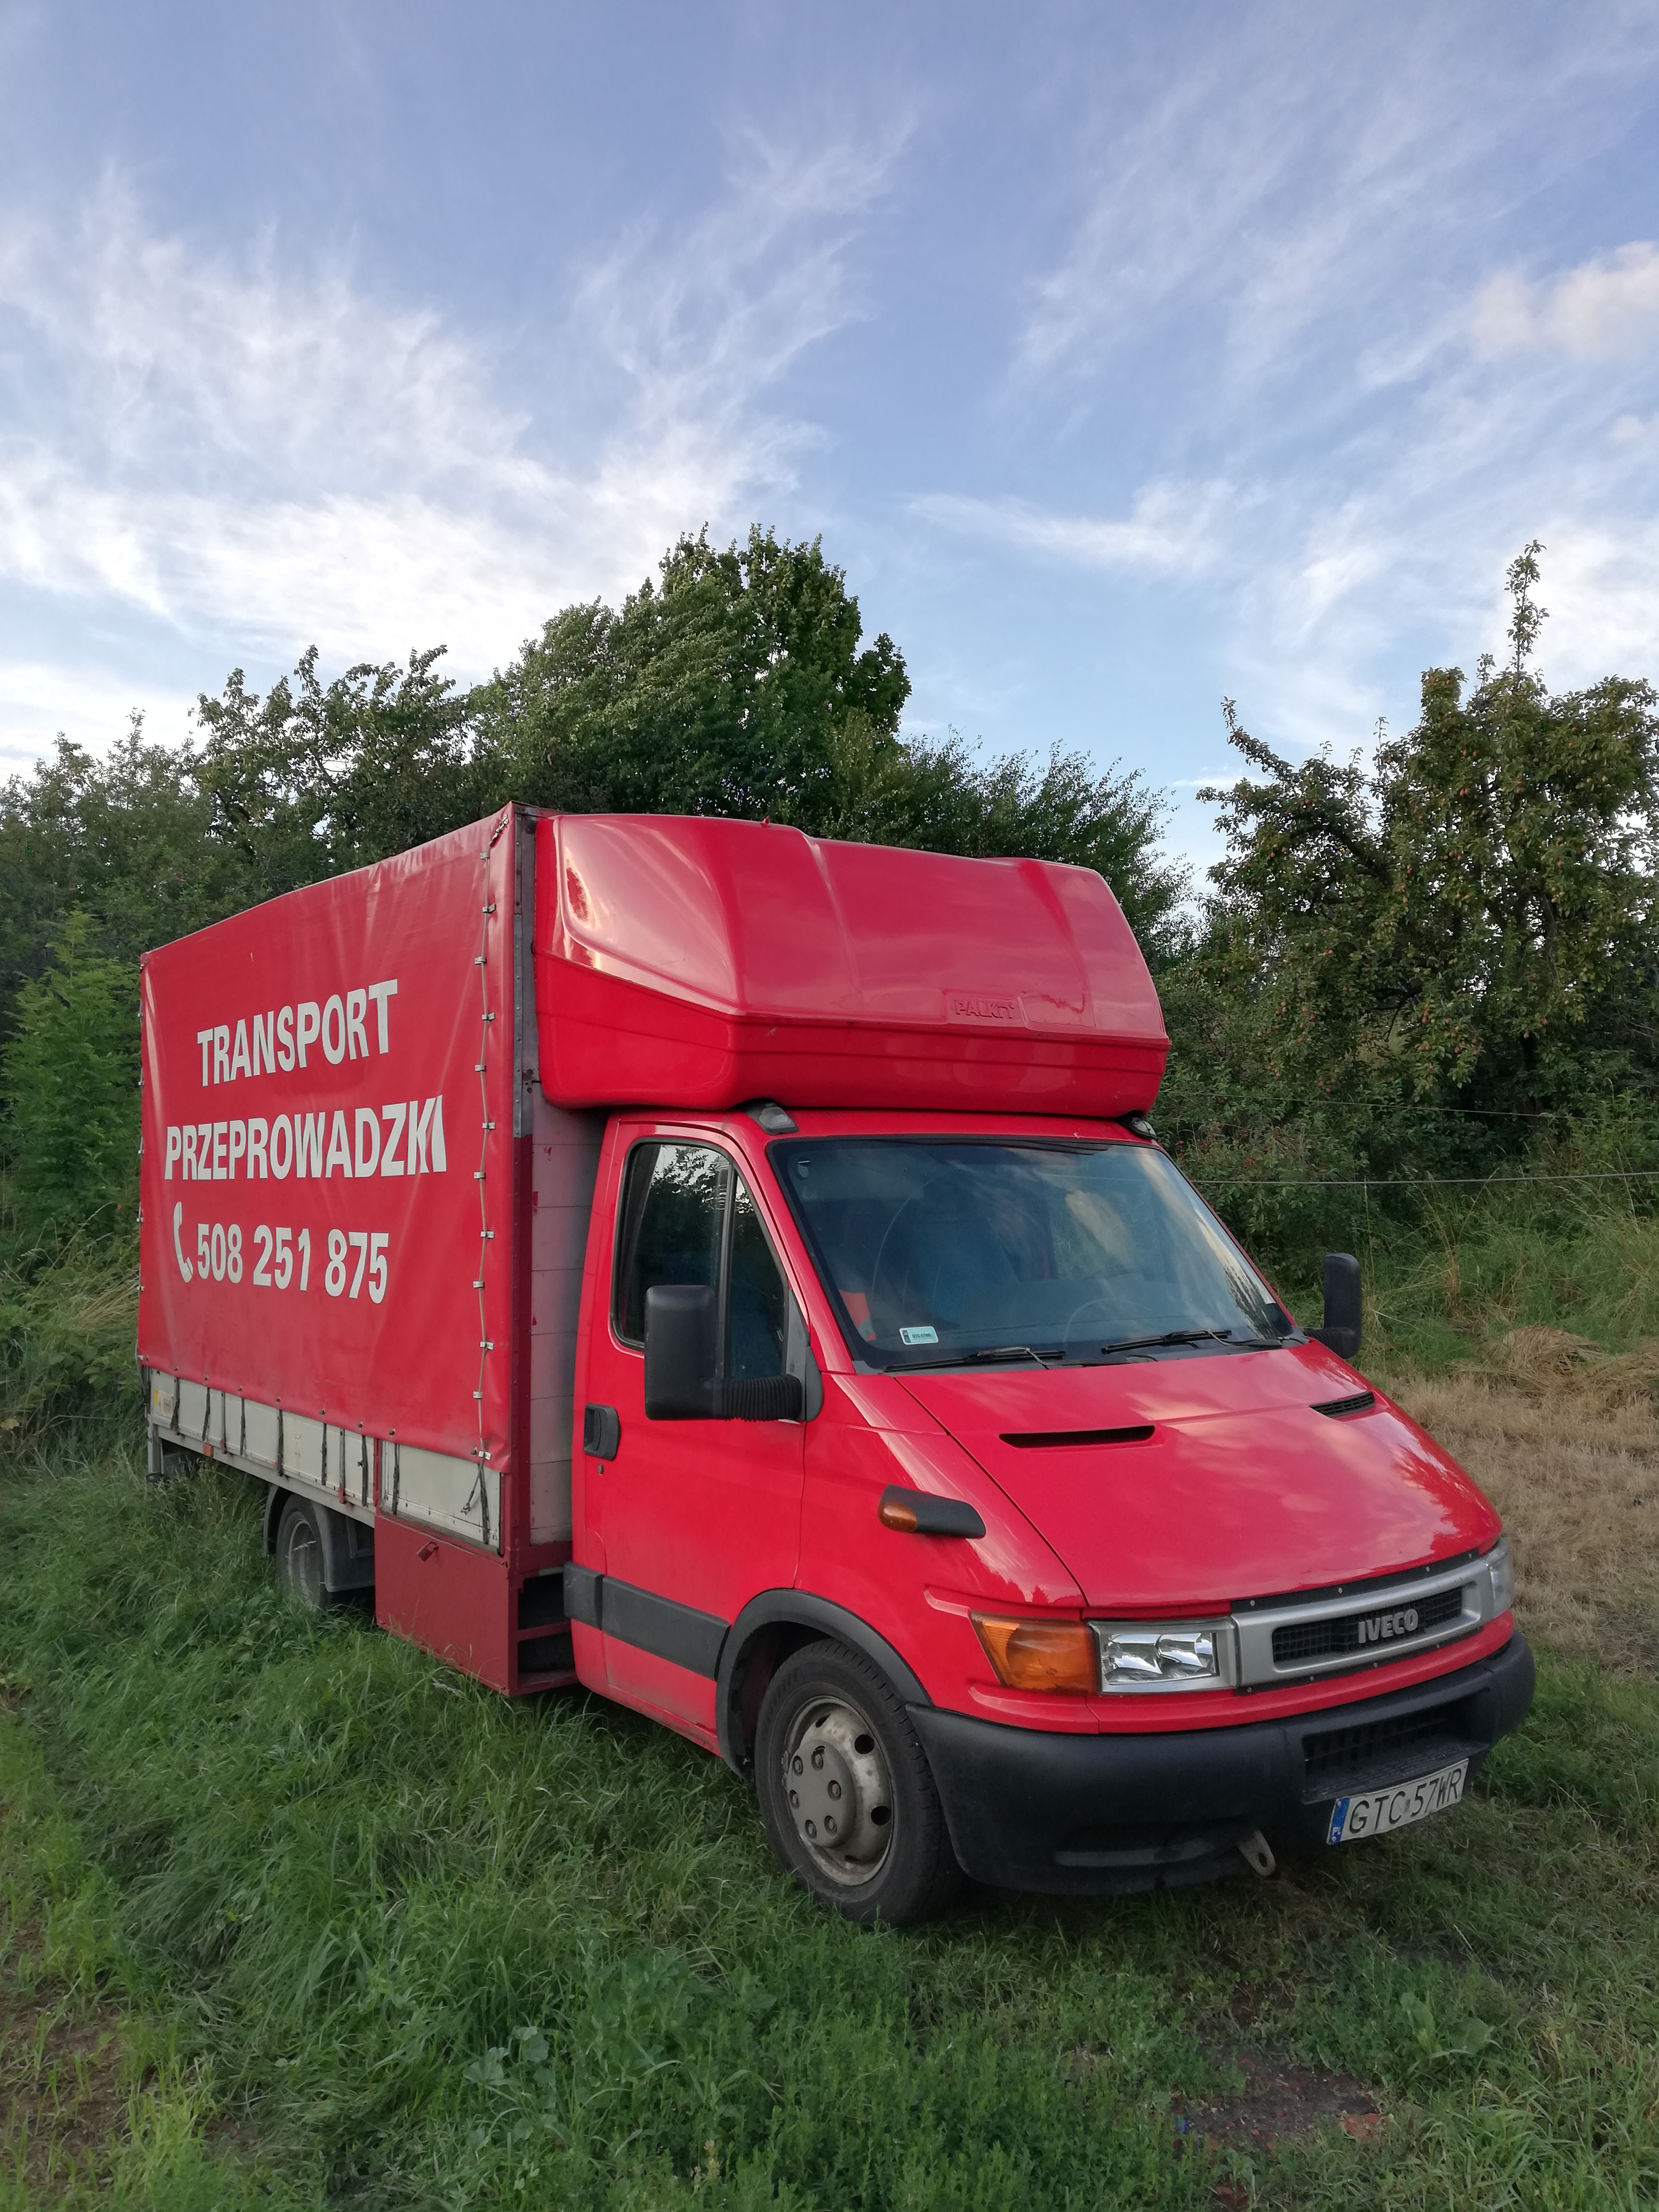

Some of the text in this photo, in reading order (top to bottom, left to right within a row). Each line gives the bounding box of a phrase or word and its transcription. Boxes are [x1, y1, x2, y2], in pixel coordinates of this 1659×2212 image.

[197, 979, 397, 1086] TRANSPORT
[164, 1095, 446, 1180] PRZEPROWADZKI
[197, 1223, 389, 1304] 508 251 875
[1358, 1609, 1419, 1644] IVECO
[1332, 1768, 1463, 1836] PL GTC 57WR
